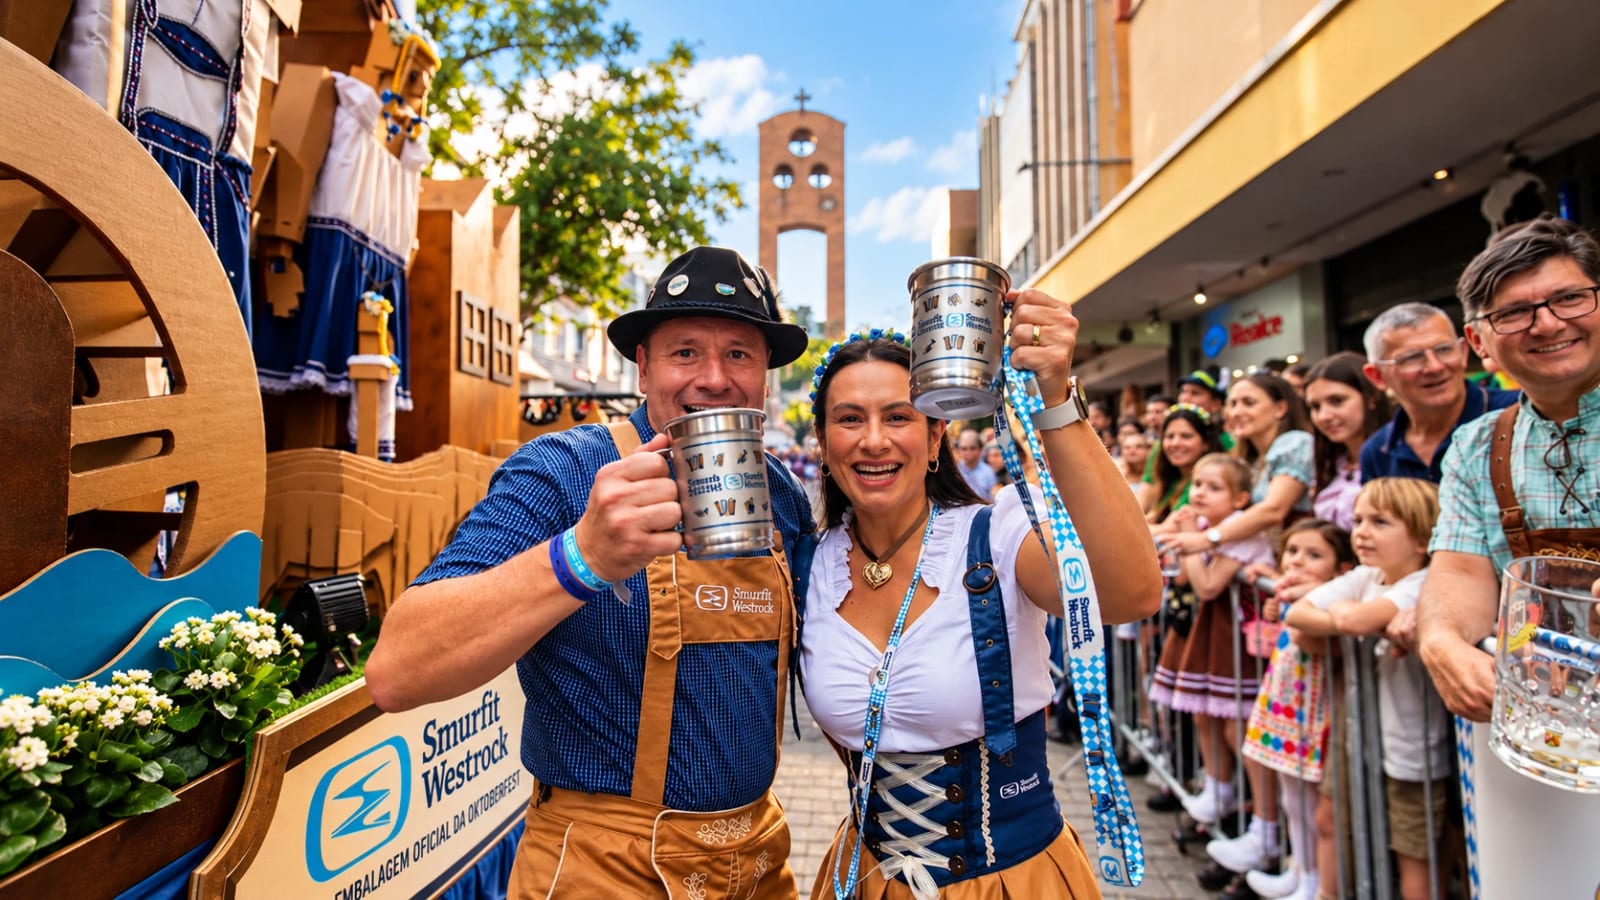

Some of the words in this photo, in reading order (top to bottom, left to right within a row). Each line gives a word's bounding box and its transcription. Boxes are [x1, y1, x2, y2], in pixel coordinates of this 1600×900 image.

[732, 587, 773, 601] Smurfit
[732, 599, 774, 614] Westrock
[422, 689, 501, 764] Smurfit
[422, 726, 509, 809] Westrock
[413, 821, 451, 863] OFICIAL
[453, 810, 466, 835] DA
[468, 769, 521, 824] OKTOBERFEST
